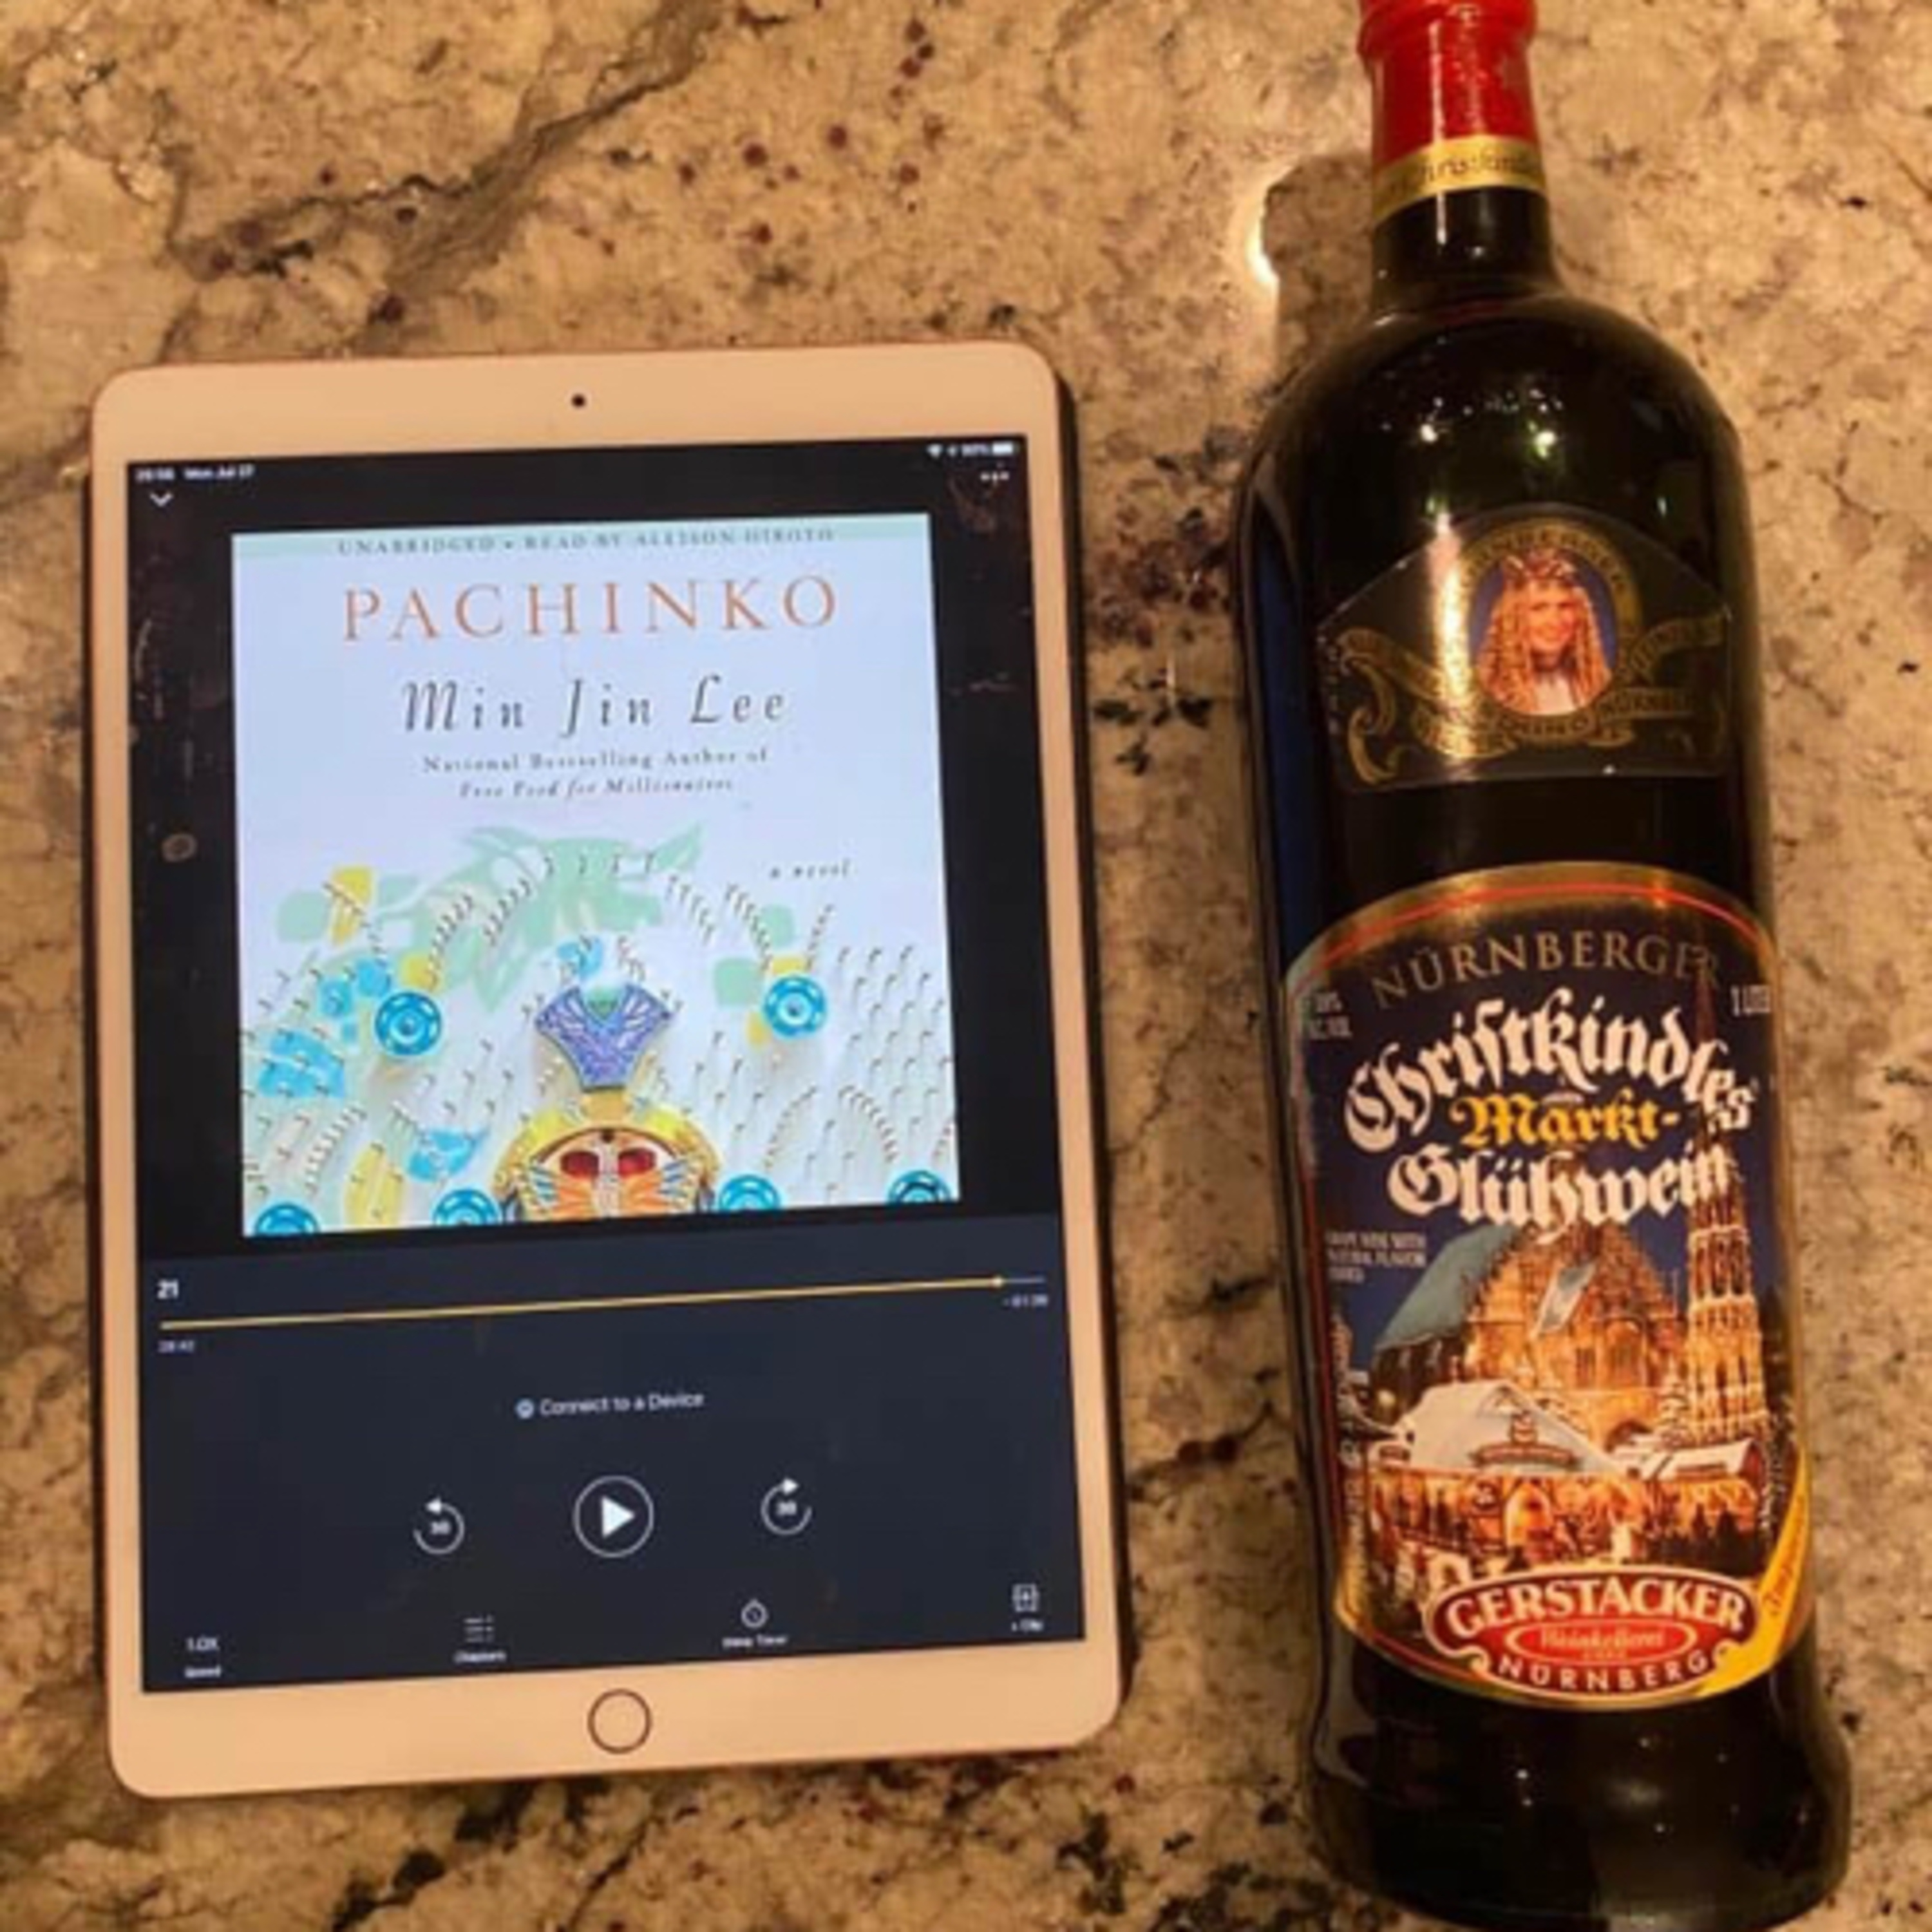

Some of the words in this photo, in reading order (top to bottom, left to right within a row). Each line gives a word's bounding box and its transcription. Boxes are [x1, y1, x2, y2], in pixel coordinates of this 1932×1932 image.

[339, 537, 495, 555] UNABRIDGED
[524, 534, 586, 550] READ
[343, 574, 837, 641] PACHINKO
[402, 680, 524, 732] Min
[559, 677, 650, 738] Jin
[689, 674, 786, 724] Lee
[422, 755, 519, 773] National
[662, 749, 737, 766] Author
[744, 746, 769, 764] of
[564, 779, 596, 800] for
[1370, 930, 1722, 1010] NÜRNBERGER
[1386, 1142, 1732, 1245] Glühwein
[156, 1278, 178, 1300] 21
[540, 1397, 607, 1416] Connect
[614, 1397, 630, 1411] to
[648, 1393, 704, 1410] Device
